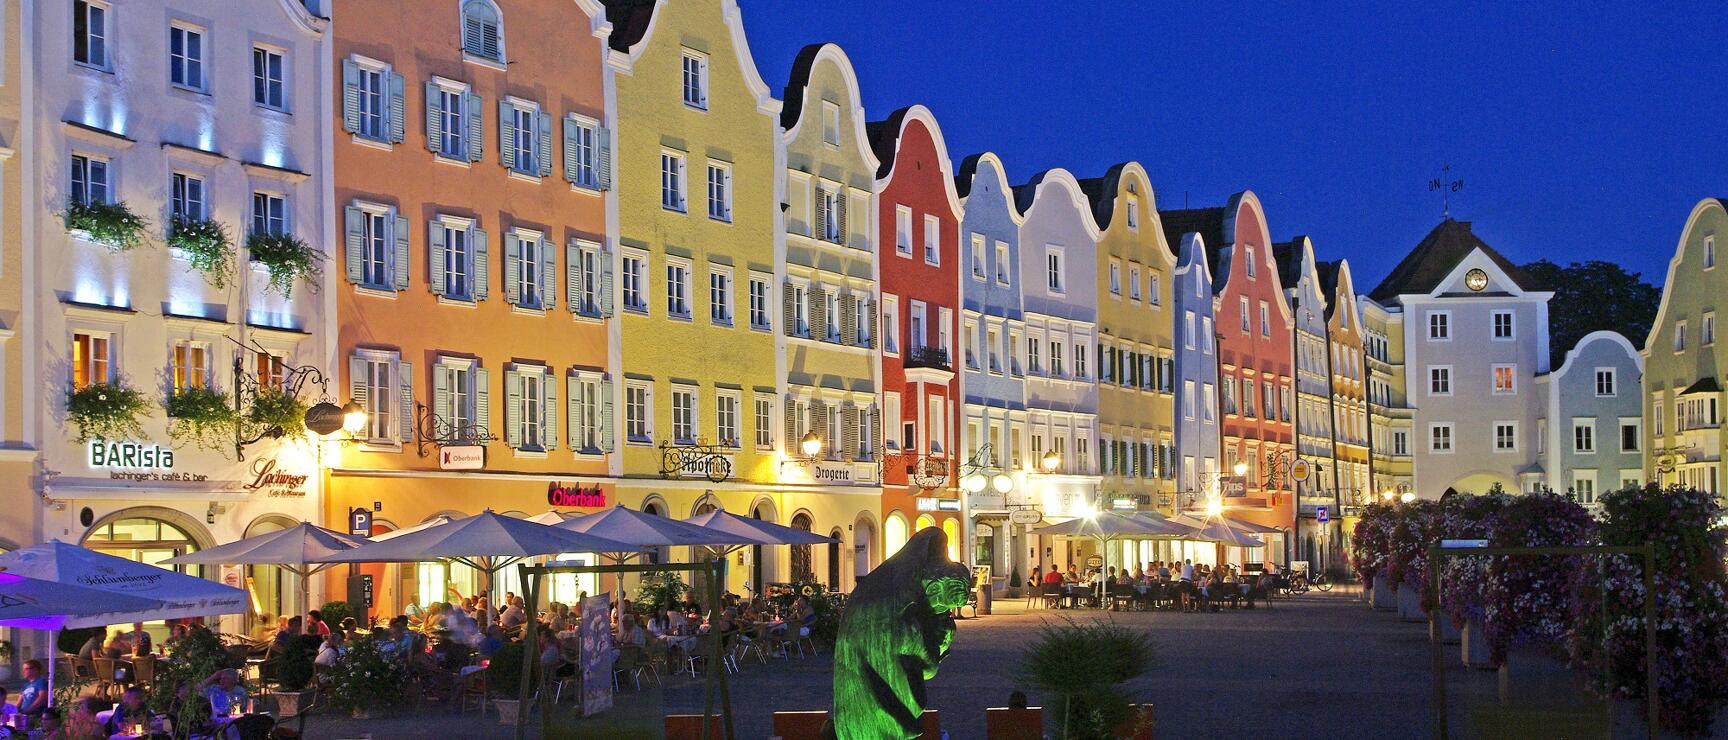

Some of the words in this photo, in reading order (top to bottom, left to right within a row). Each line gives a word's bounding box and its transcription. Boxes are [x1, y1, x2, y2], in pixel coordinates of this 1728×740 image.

[92, 442, 173, 468] BARista
[453, 455, 481, 463] Oberbank
[110, 471, 159, 482] lachinger's
[182, 472, 191, 481] &
[193, 473, 208, 482] bar
[243, 458, 308, 490] Lachinger
[815, 465, 850, 482] Drogerie
[552, 487, 606, 508] Oberbank
[355, 514, 366, 530] P
